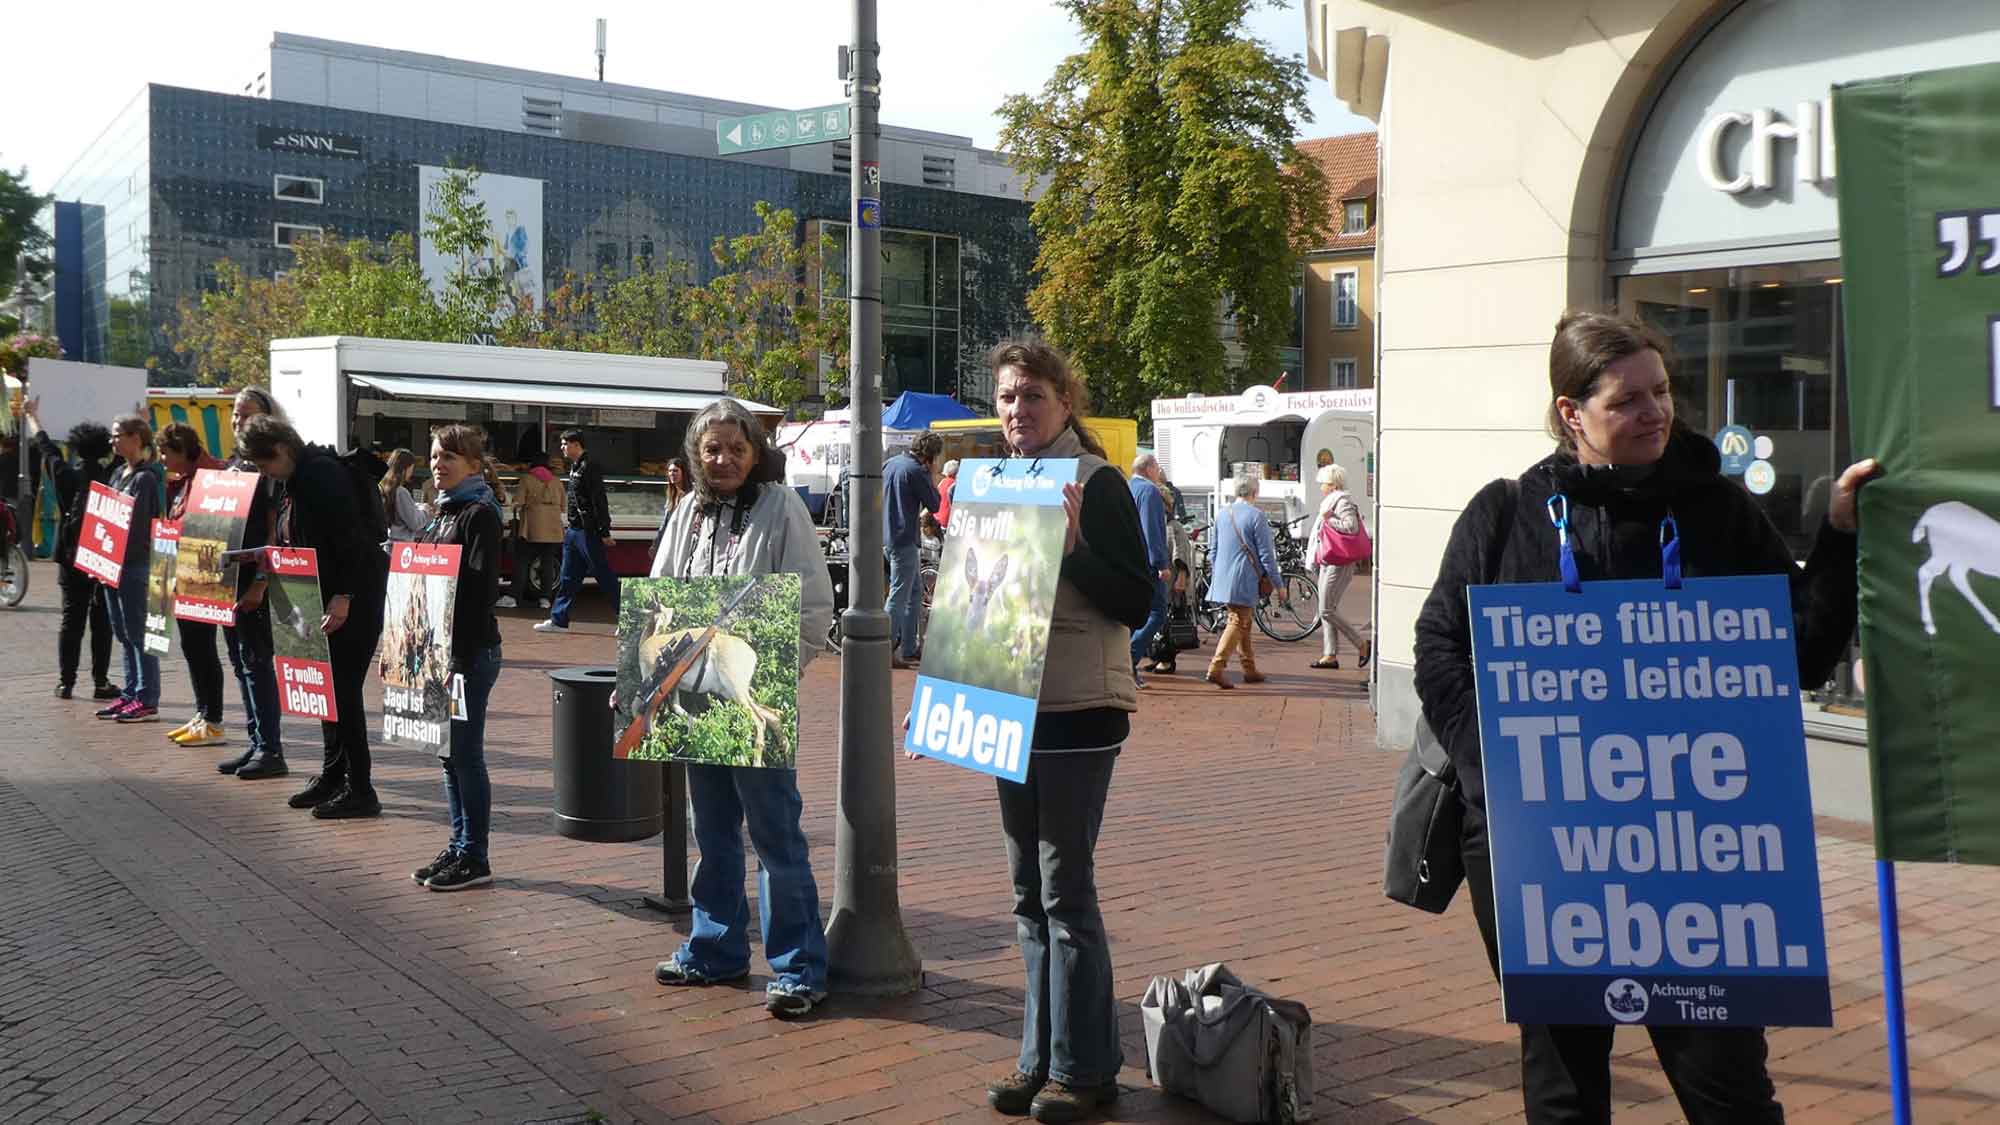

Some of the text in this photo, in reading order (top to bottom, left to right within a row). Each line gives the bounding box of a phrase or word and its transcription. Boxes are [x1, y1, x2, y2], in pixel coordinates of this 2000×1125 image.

[1698, 101, 1836, 193] CH
[949, 508, 1015, 541] Sie will
[1482, 600, 1788, 648] Tiere fühlen.
[283, 663, 325, 687] Er wollte
[1487, 656, 1789, 702] Tiere leiden.
[286, 683, 329, 718] leben
[385, 686, 425, 713] Jagd ist
[383, 713, 441, 745] grausam
[913, 685, 1024, 773] leben
[1499, 716, 1748, 802] Tiere
[1551, 810, 1785, 872] wollen
[1520, 884, 1809, 968] leben.
[1651, 983, 1726, 1000] Achtung für
[1675, 999, 1728, 1020] Tiere
